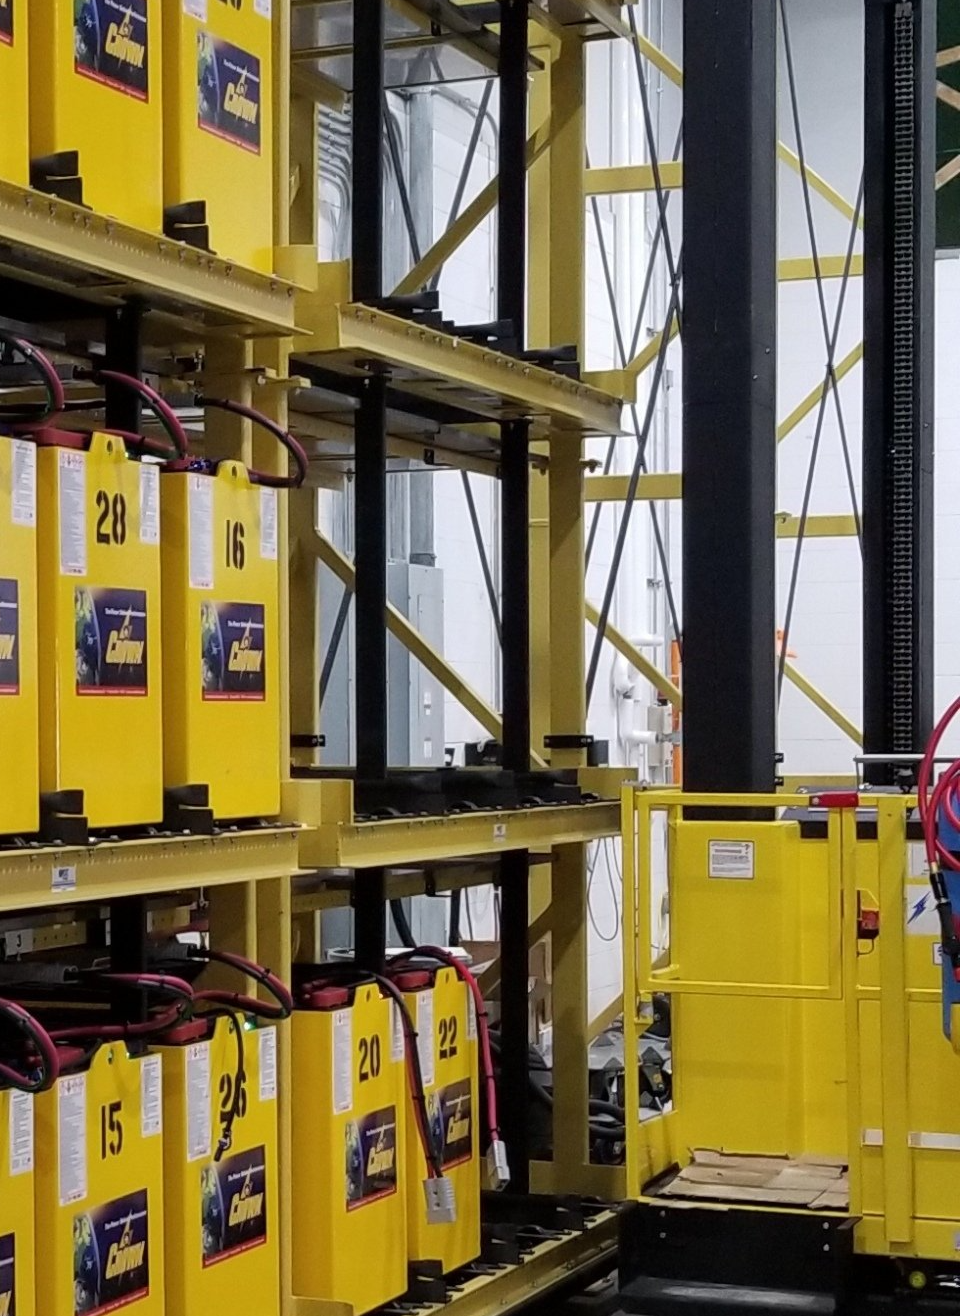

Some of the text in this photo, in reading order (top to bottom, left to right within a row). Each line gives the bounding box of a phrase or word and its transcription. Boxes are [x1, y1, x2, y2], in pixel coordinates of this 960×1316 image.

[95, 490, 126, 545] 28
[226, 519, 245, 570] 16
[358, 1034, 381, 1083] 20
[438, 1015, 458, 1060] 22
[101, 1100, 123, 1160] 15
